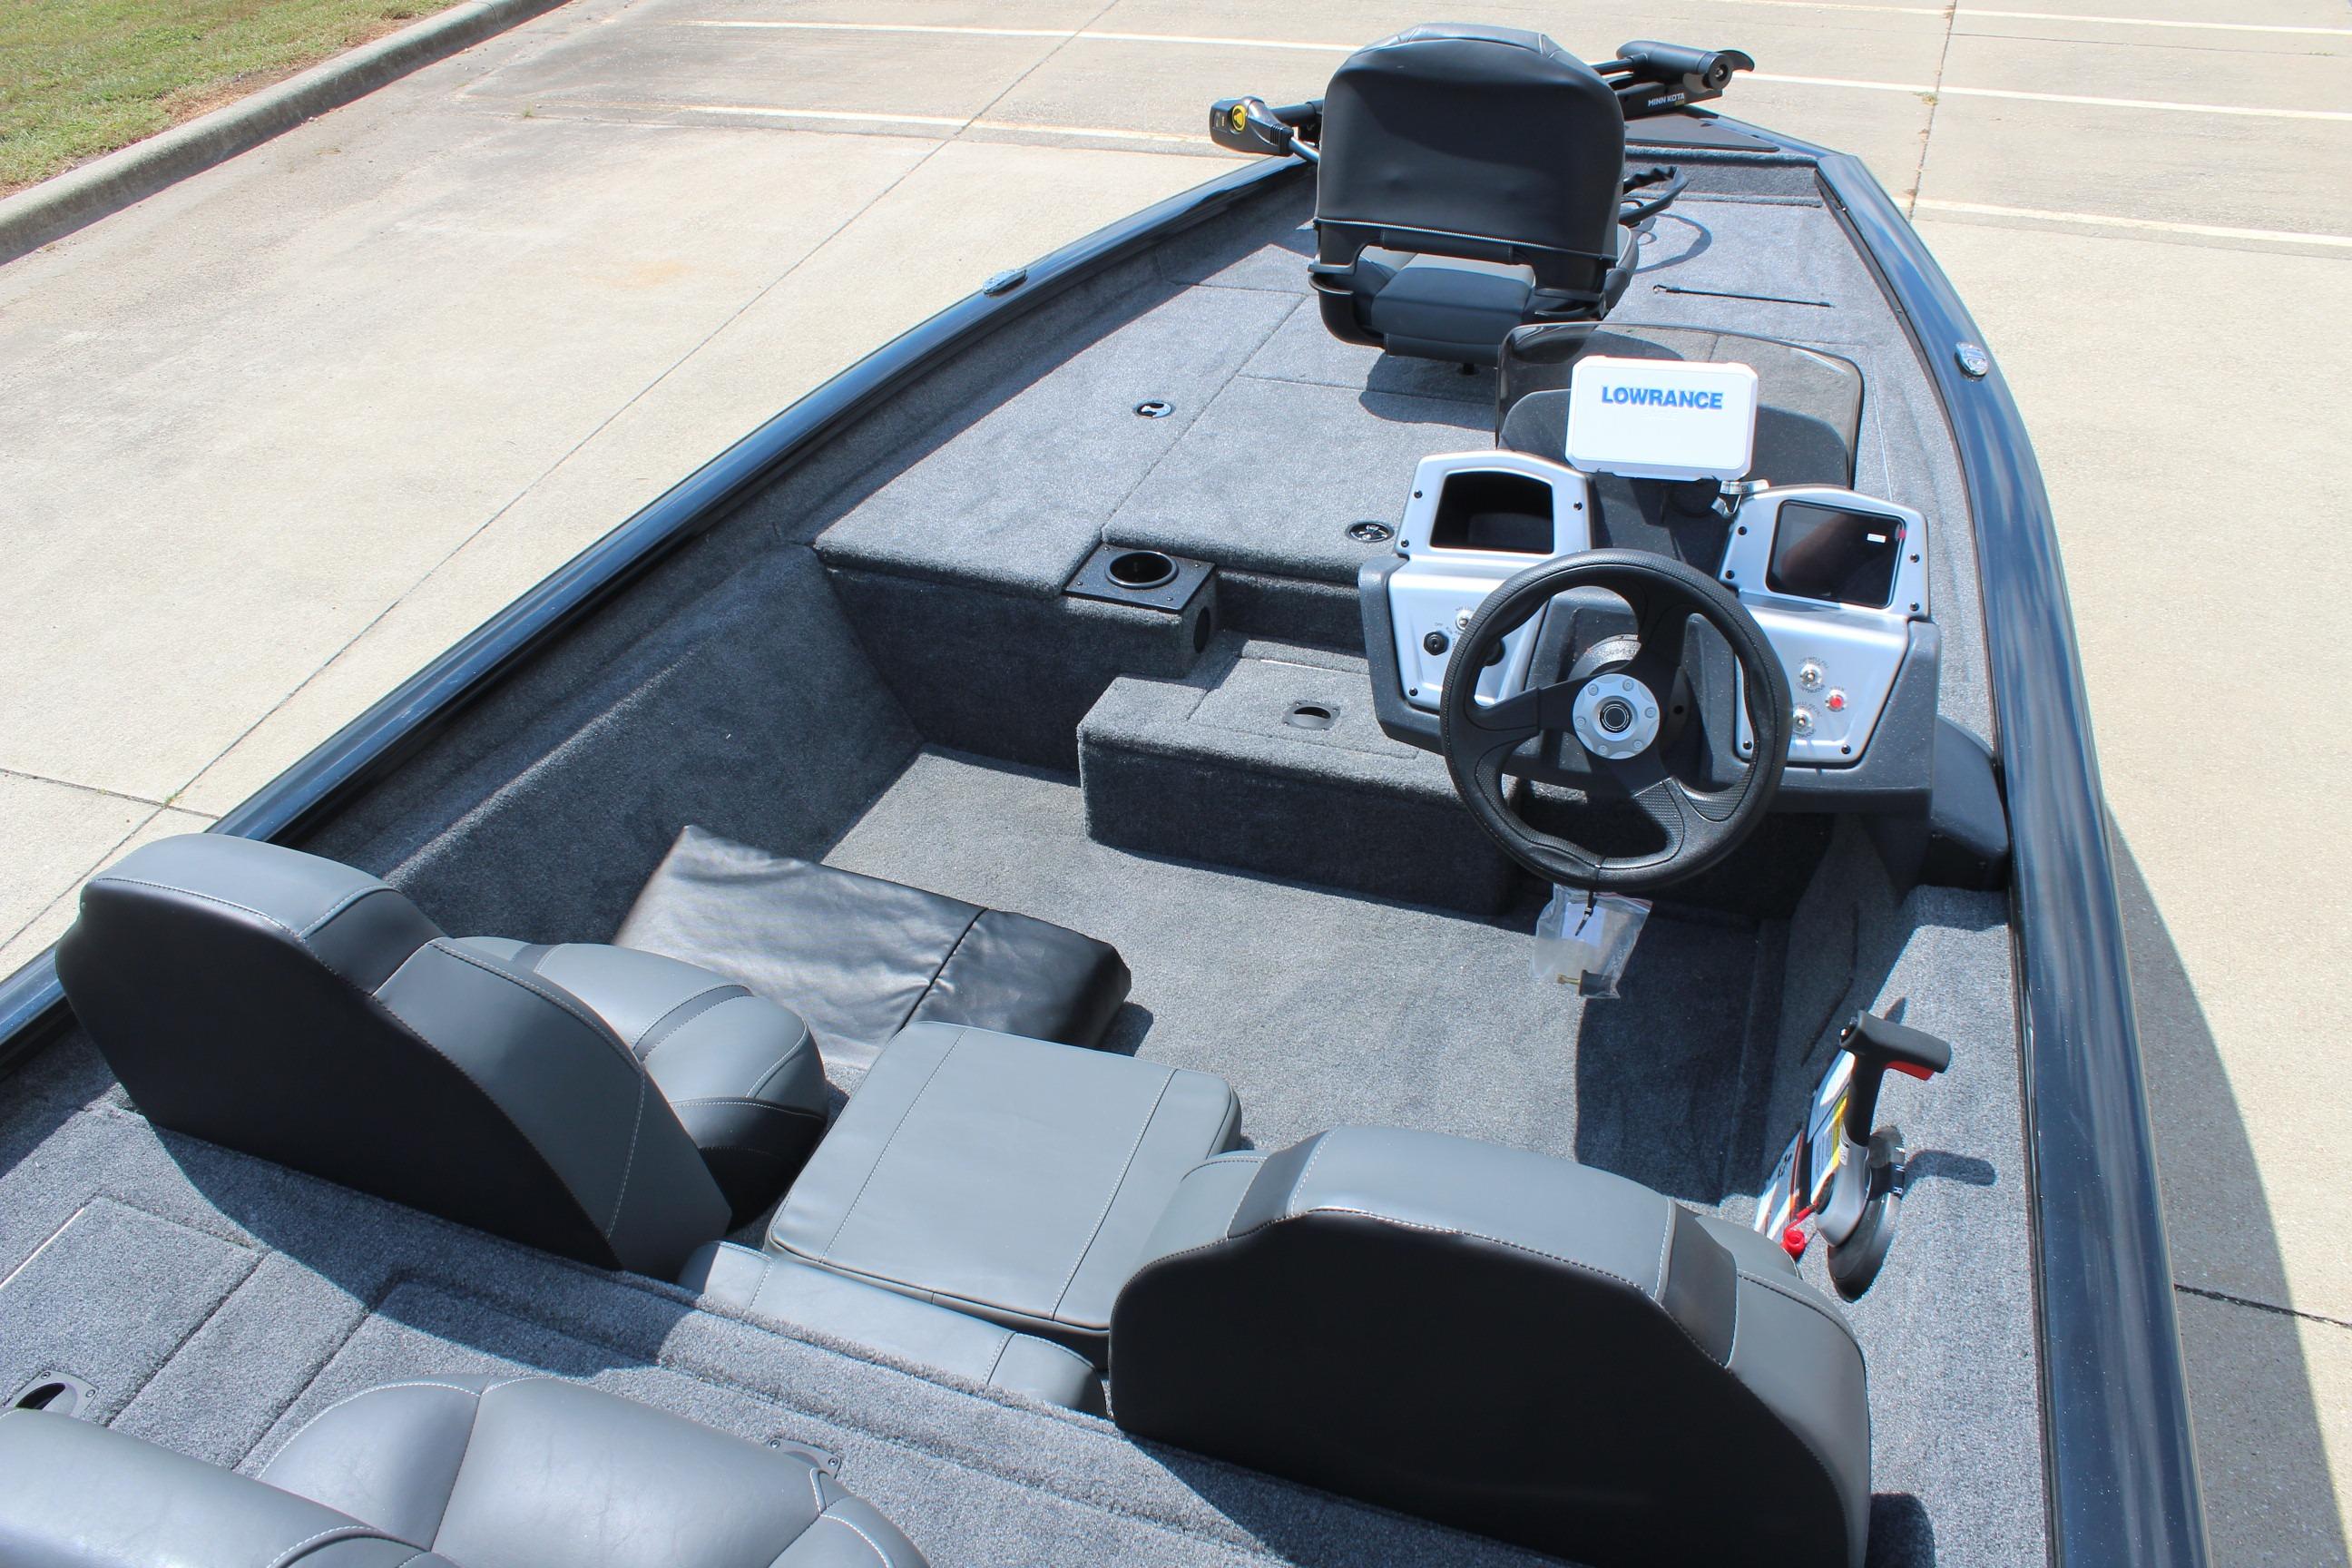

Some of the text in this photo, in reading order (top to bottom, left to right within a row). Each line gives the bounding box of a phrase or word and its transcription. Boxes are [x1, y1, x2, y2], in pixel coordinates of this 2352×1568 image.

[1647, 96, 1667, 107] MINN
[1667, 93, 1685, 103] KOTA
[1602, 386, 1724, 410] LOWRANCE
